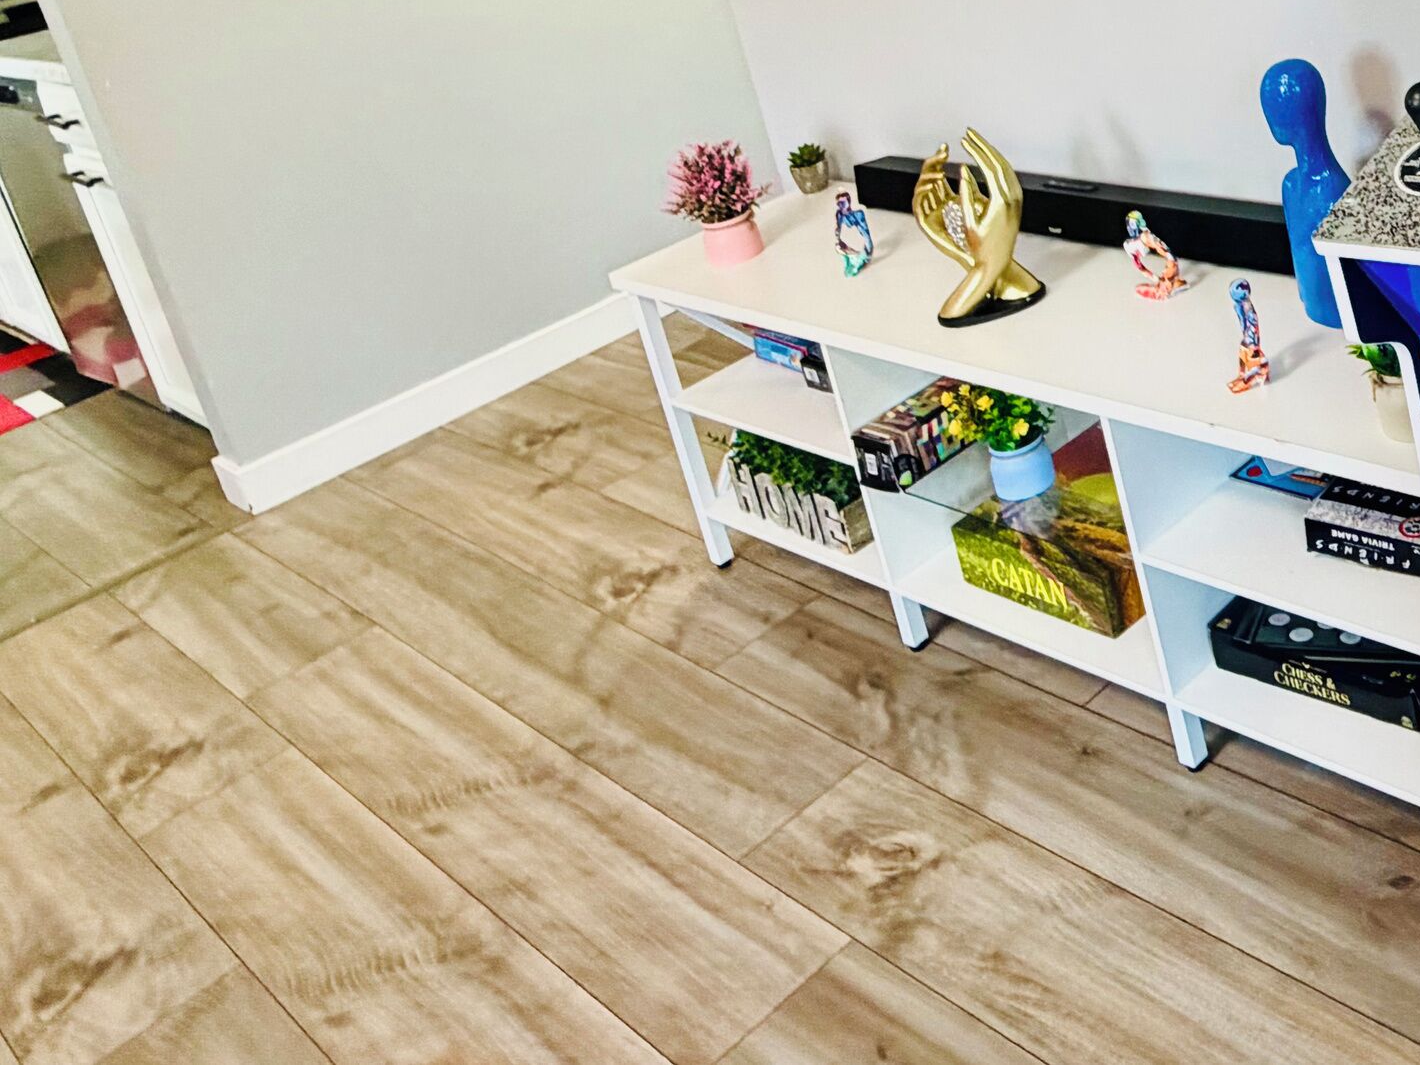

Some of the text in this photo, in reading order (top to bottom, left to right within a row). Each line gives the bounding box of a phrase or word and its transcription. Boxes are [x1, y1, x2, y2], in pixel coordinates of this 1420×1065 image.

[728, 457, 852, 554] HOME
[1331, 529, 1359, 542] GAME
[1361, 536, 1395, 551] TRIVIA
[992, 557, 1068, 613] CATAN
[1274, 670, 1351, 706] CHECKERS
[1282, 663, 1323, 686] CHESS
[1326, 677, 1336, 690] &
